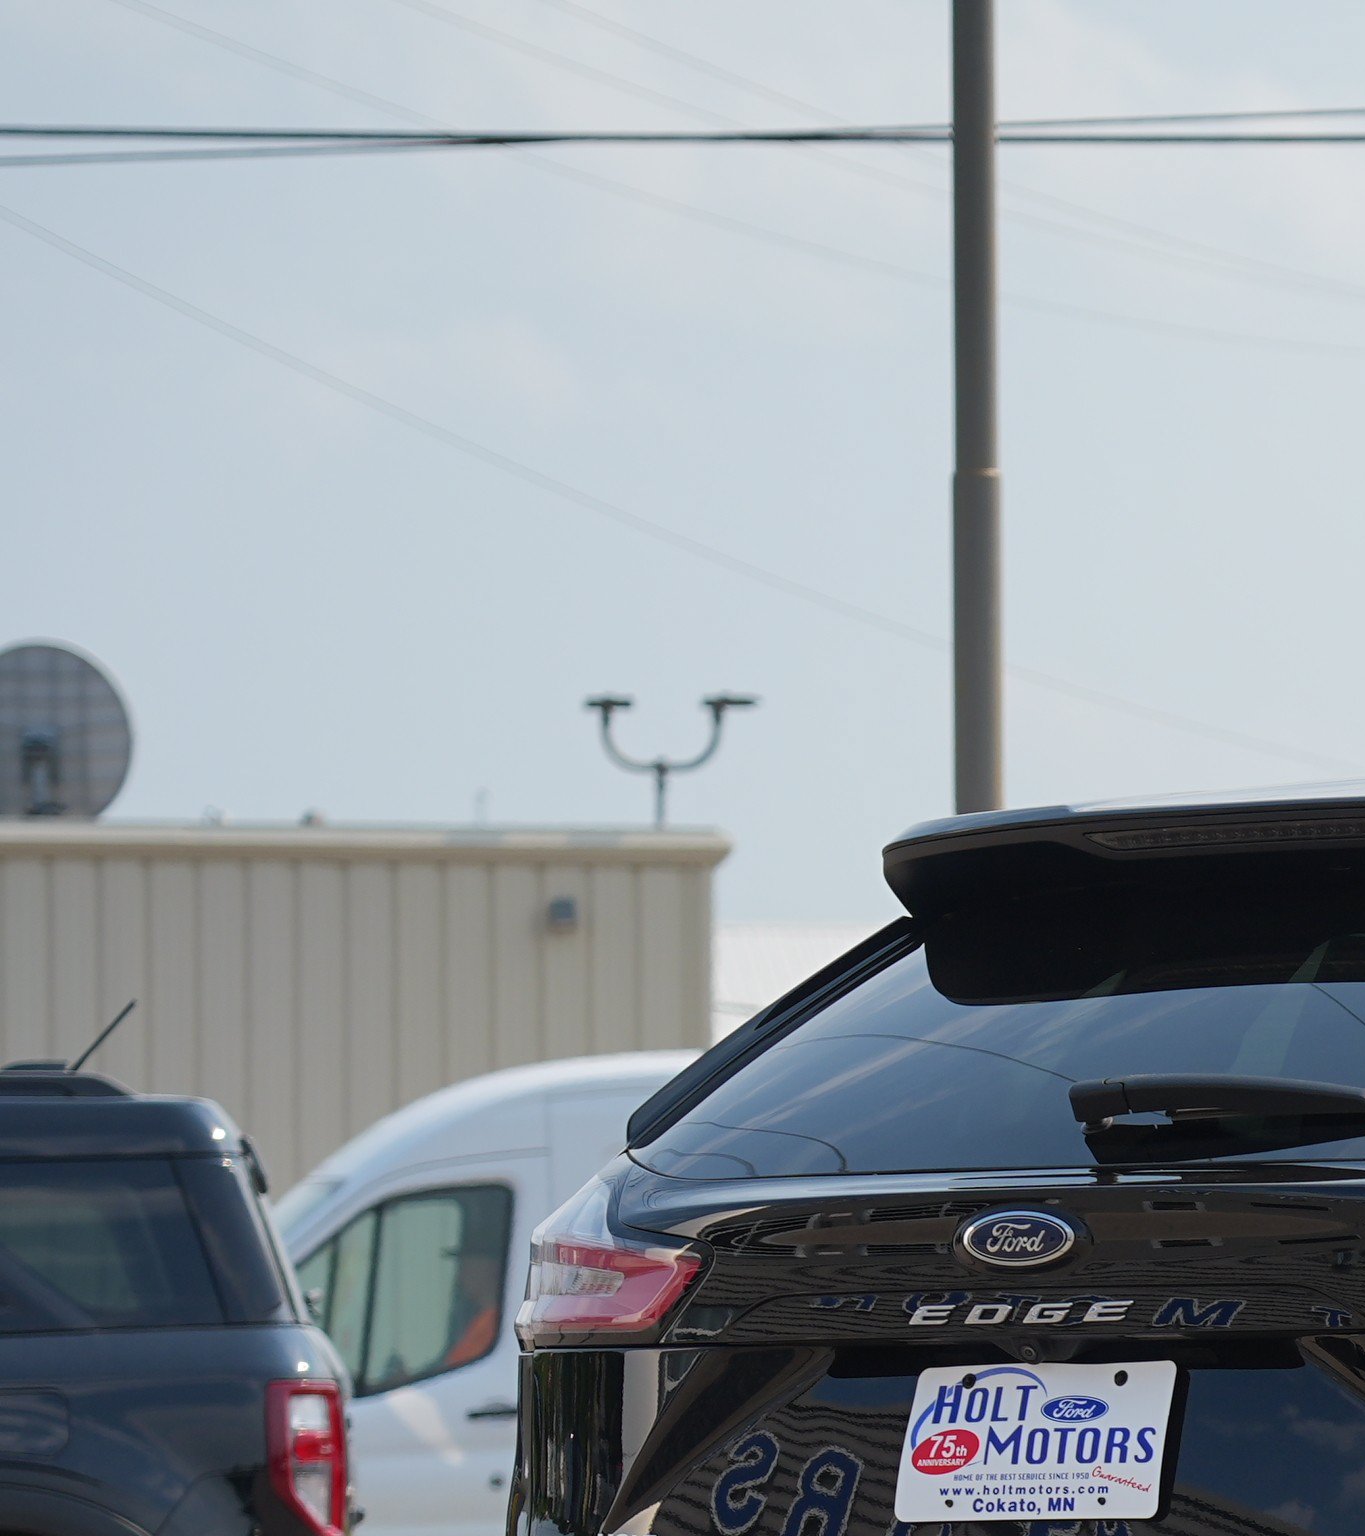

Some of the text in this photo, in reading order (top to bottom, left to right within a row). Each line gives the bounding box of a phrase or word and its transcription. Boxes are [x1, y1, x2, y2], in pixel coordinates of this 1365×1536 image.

[986, 1222, 1044, 1252] Ford
[907, 1300, 1135, 1327] EDGE
[931, 1385, 1039, 1424] HOLT
[1052, 1399, 1096, 1420] Ford
[928, 1434, 968, 1459] 75th
[983, 1424, 1157, 1466] MOTORS
[916, 1458, 966, 1468] ANNIVERSARY
[953, 1474, 973, 1482] HOME
[975, 1474, 985, 1482] OF
[1000, 1473, 1016, 1481] BEST
[1018, 1473, 1046, 1481] SERVICE
[1071, 1472, 1090, 1480] 1950
[1091, 1465, 1152, 1494] Guaranteed
[939, 1484, 1109, 1496] www.holtmotors.com
[972, 1497, 1075, 1515] Cokato, MN
